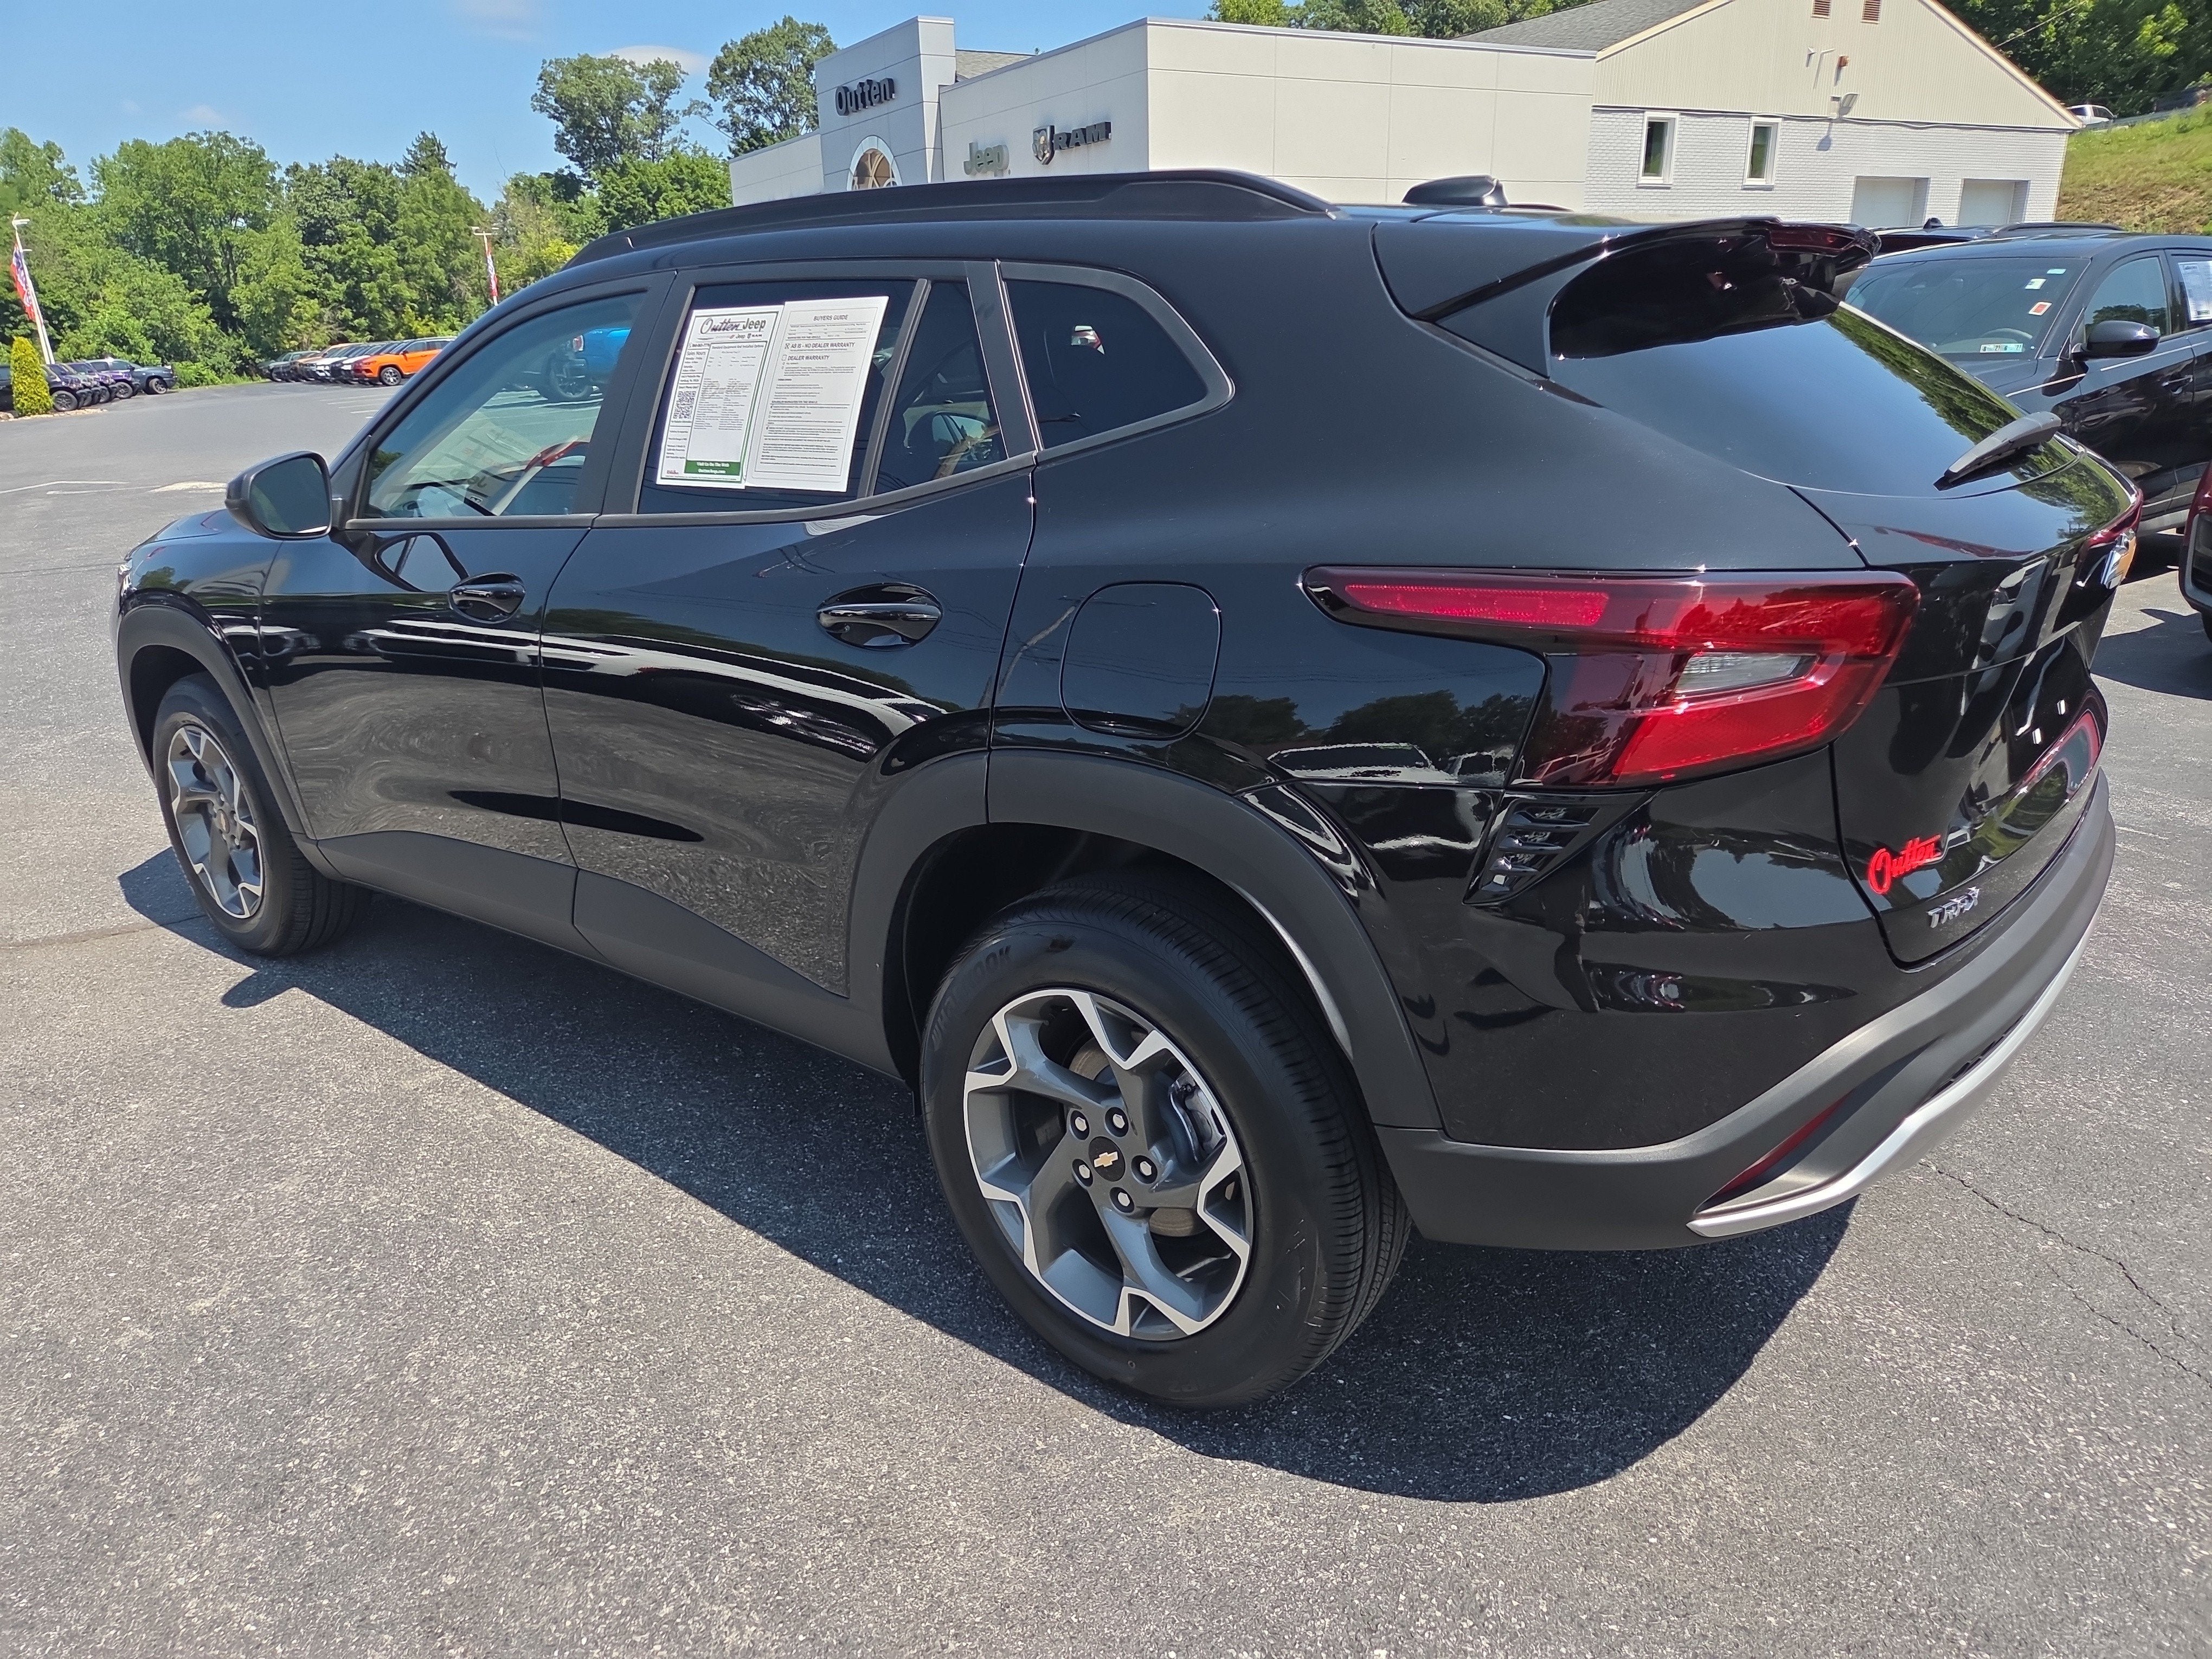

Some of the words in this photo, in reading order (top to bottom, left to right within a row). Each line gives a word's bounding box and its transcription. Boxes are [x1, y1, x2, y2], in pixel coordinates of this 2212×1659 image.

[835, 78, 895, 116] Outten
[1053, 121, 1111, 150] RAM
[963, 142, 1009, 177] Jeep
[700, 317, 745, 335] Outten
[742, 318, 766, 332] Jeep
[1869, 834, 1941, 895] Outten
